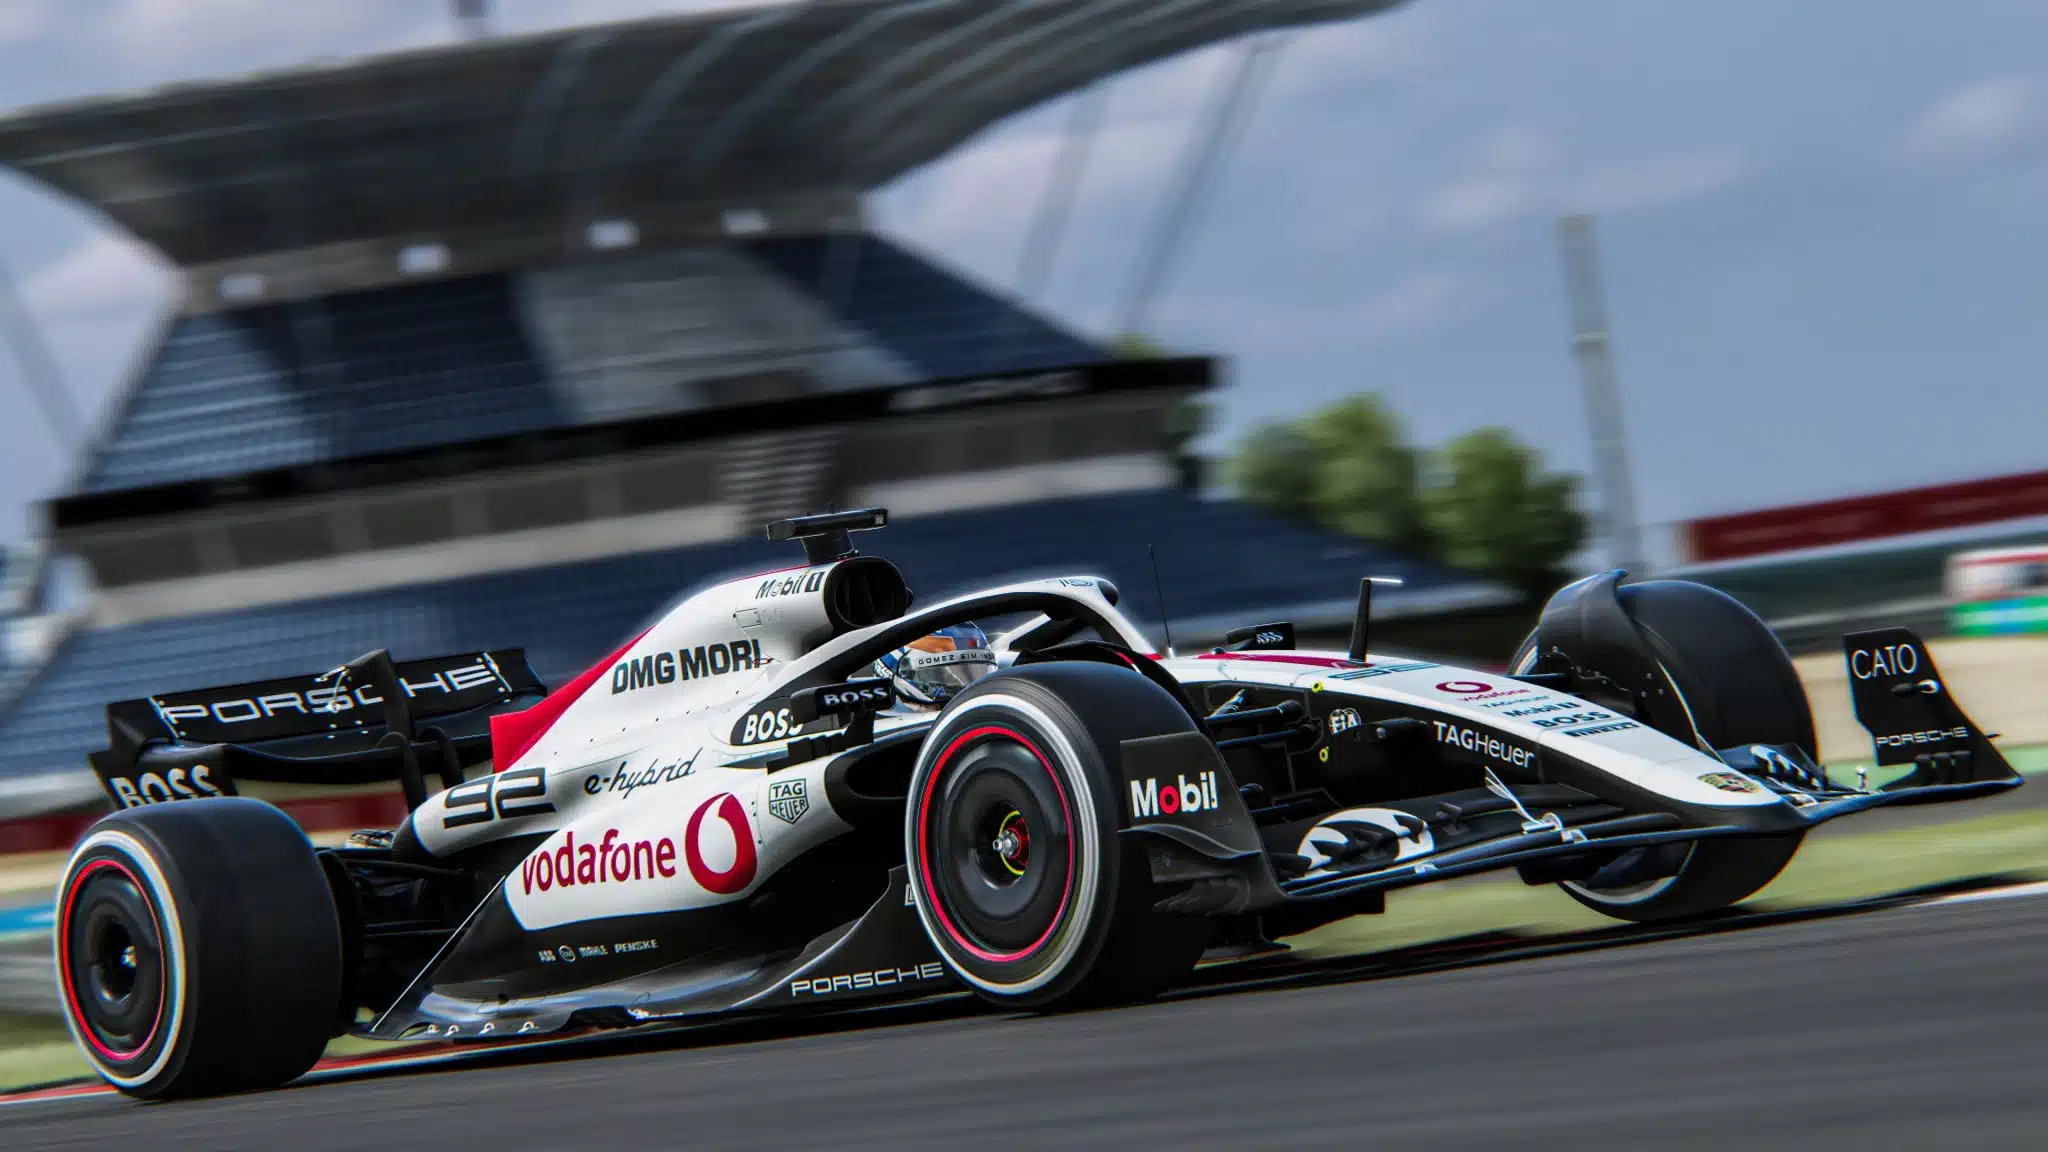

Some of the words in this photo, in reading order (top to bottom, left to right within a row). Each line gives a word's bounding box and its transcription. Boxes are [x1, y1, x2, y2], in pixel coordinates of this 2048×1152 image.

[755, 573, 802, 600] Mobil
[611, 651, 675, 695] DMG
[679, 639, 761, 681] MORI
[918, 654, 955, 665] GOMEZ
[960, 652, 977, 660] SIM
[1852, 643, 1918, 680] CATO
[824, 686, 888, 706] BOSS
[1532, 710, 1613, 728] BOSS
[1433, 720, 1536, 769] TAGHeuer
[1876, 726, 1969, 747] PORSCHE
[583, 747, 704, 800] e-hybrid
[441, 766, 557, 830] 92
[773, 781, 804, 799] TAG
[1130, 771, 1218, 819] Mobil
[771, 798, 808, 821] HEUER
[522, 828, 677, 896] vodafone
[614, 939, 659, 954] PENSKE
[791, 961, 944, 996] PORSCHE
